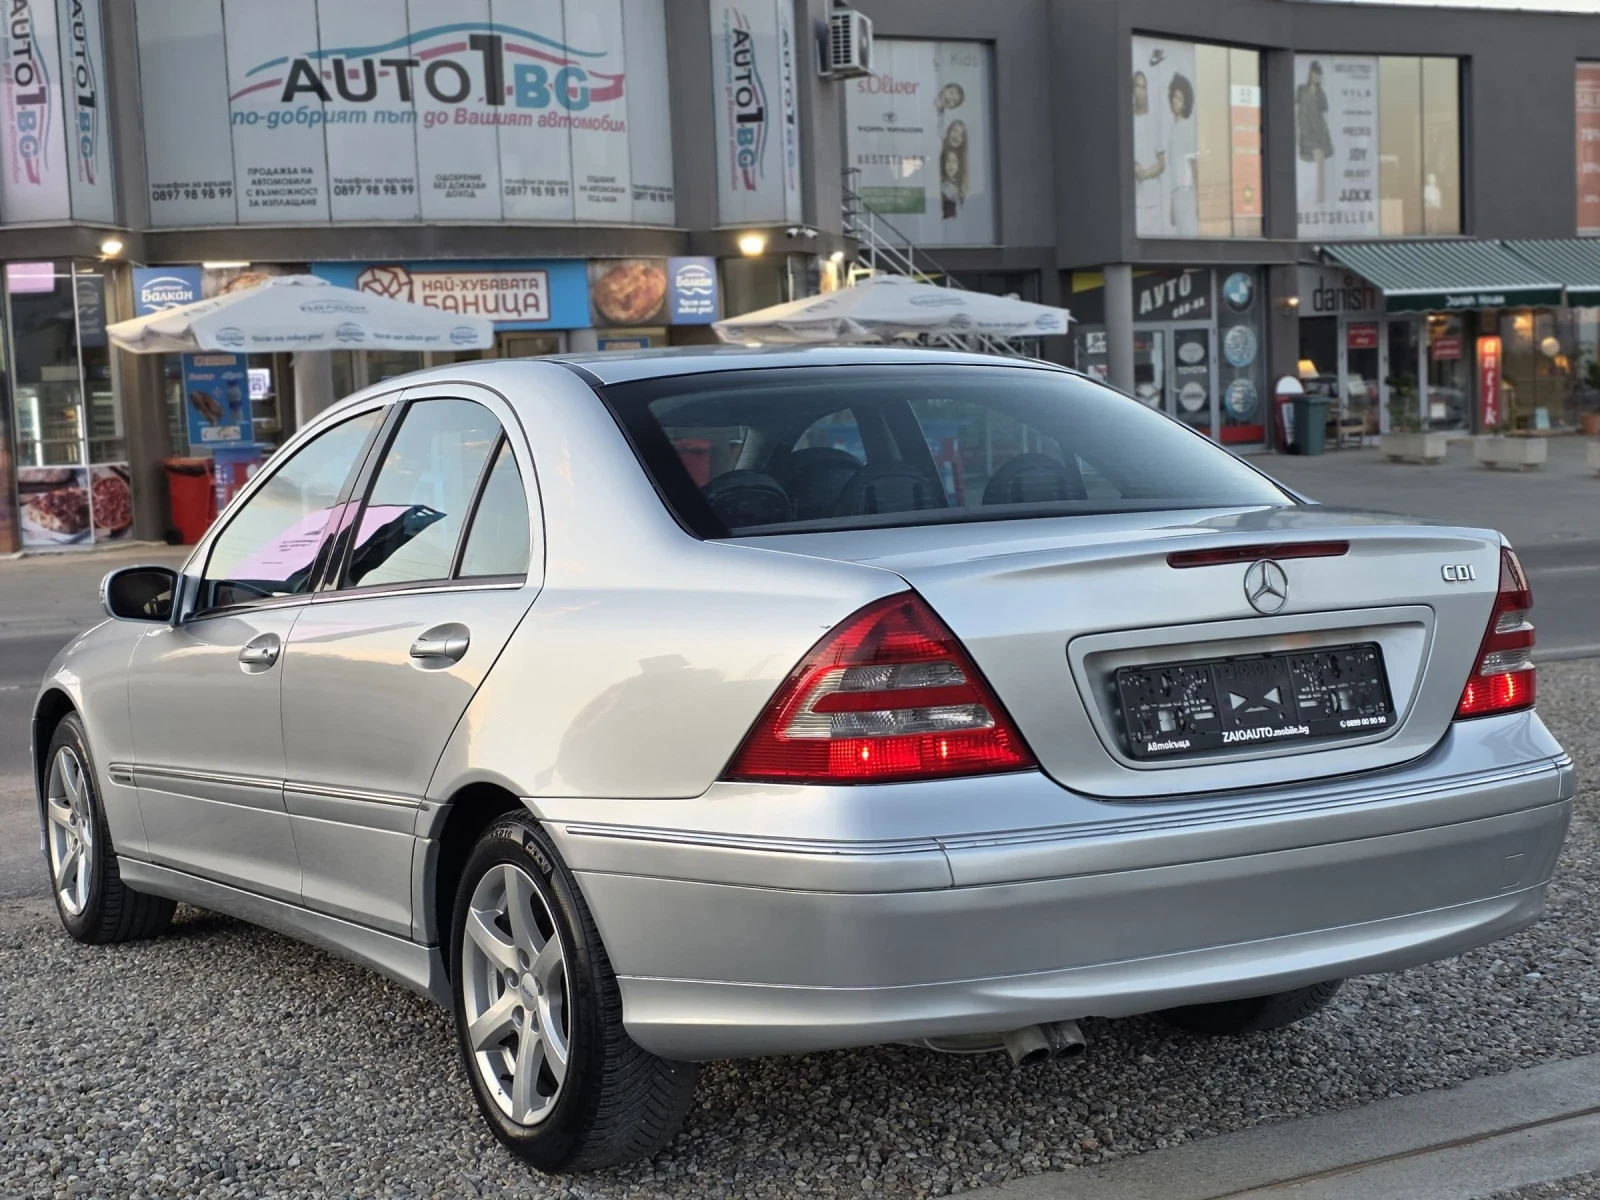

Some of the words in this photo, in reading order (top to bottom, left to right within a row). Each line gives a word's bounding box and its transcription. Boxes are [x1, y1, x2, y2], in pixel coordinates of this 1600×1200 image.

[857, 74, 920, 94] s.Oliver
[231, 105, 367, 129] по-добрият
[373, 109, 418, 124] път
[424, 110, 449, 128] до
[454, 107, 533, 127] Вашият
[537, 111, 627, 133] автомобил
[247, 167, 299, 176] ПРОДАЖБА
[301, 167, 313, 175] НА
[251, 178, 312, 186] АВТОМОБИЛИ
[152, 189, 180, 201] 0897
[184, 189, 198, 200] 98
[202, 188, 215, 199] 98
[219, 187, 232, 199] 99
[246, 188, 253, 197] С
[255, 187, 318, 196] ВЪЗМОЖНОСТ
[334, 184, 362, 196] 0897
[366, 184, 380, 196] 98
[383, 184, 397, 196] 98
[400, 184, 414, 195] 99
[504, 185, 528, 196] 0897
[531, 186, 542, 197] 98
[544, 186, 556, 197] 98
[558, 187, 569, 197] 99
[248, 199, 260, 208] ЗА
[262, 198, 317, 207] ИЗПЛАЩАНЕ
[1296, 209, 1374, 225] BESTSELLER
[421, 276, 539, 292] НАЙ-ХУБАВАТА
[676, 275, 712, 287] Балкан
[142, 289, 193, 302] Балкан
[1312, 275, 1375, 312] danish
[423, 292, 540, 318] БАНИЦА
[1178, 366, 1208, 375] TOYOTA
[1440, 564, 1476, 582] CDI
[1221, 725, 1310, 743] ZAIOAUTO.mobile.bg
[1147, 740, 1191, 752] Автокъща
